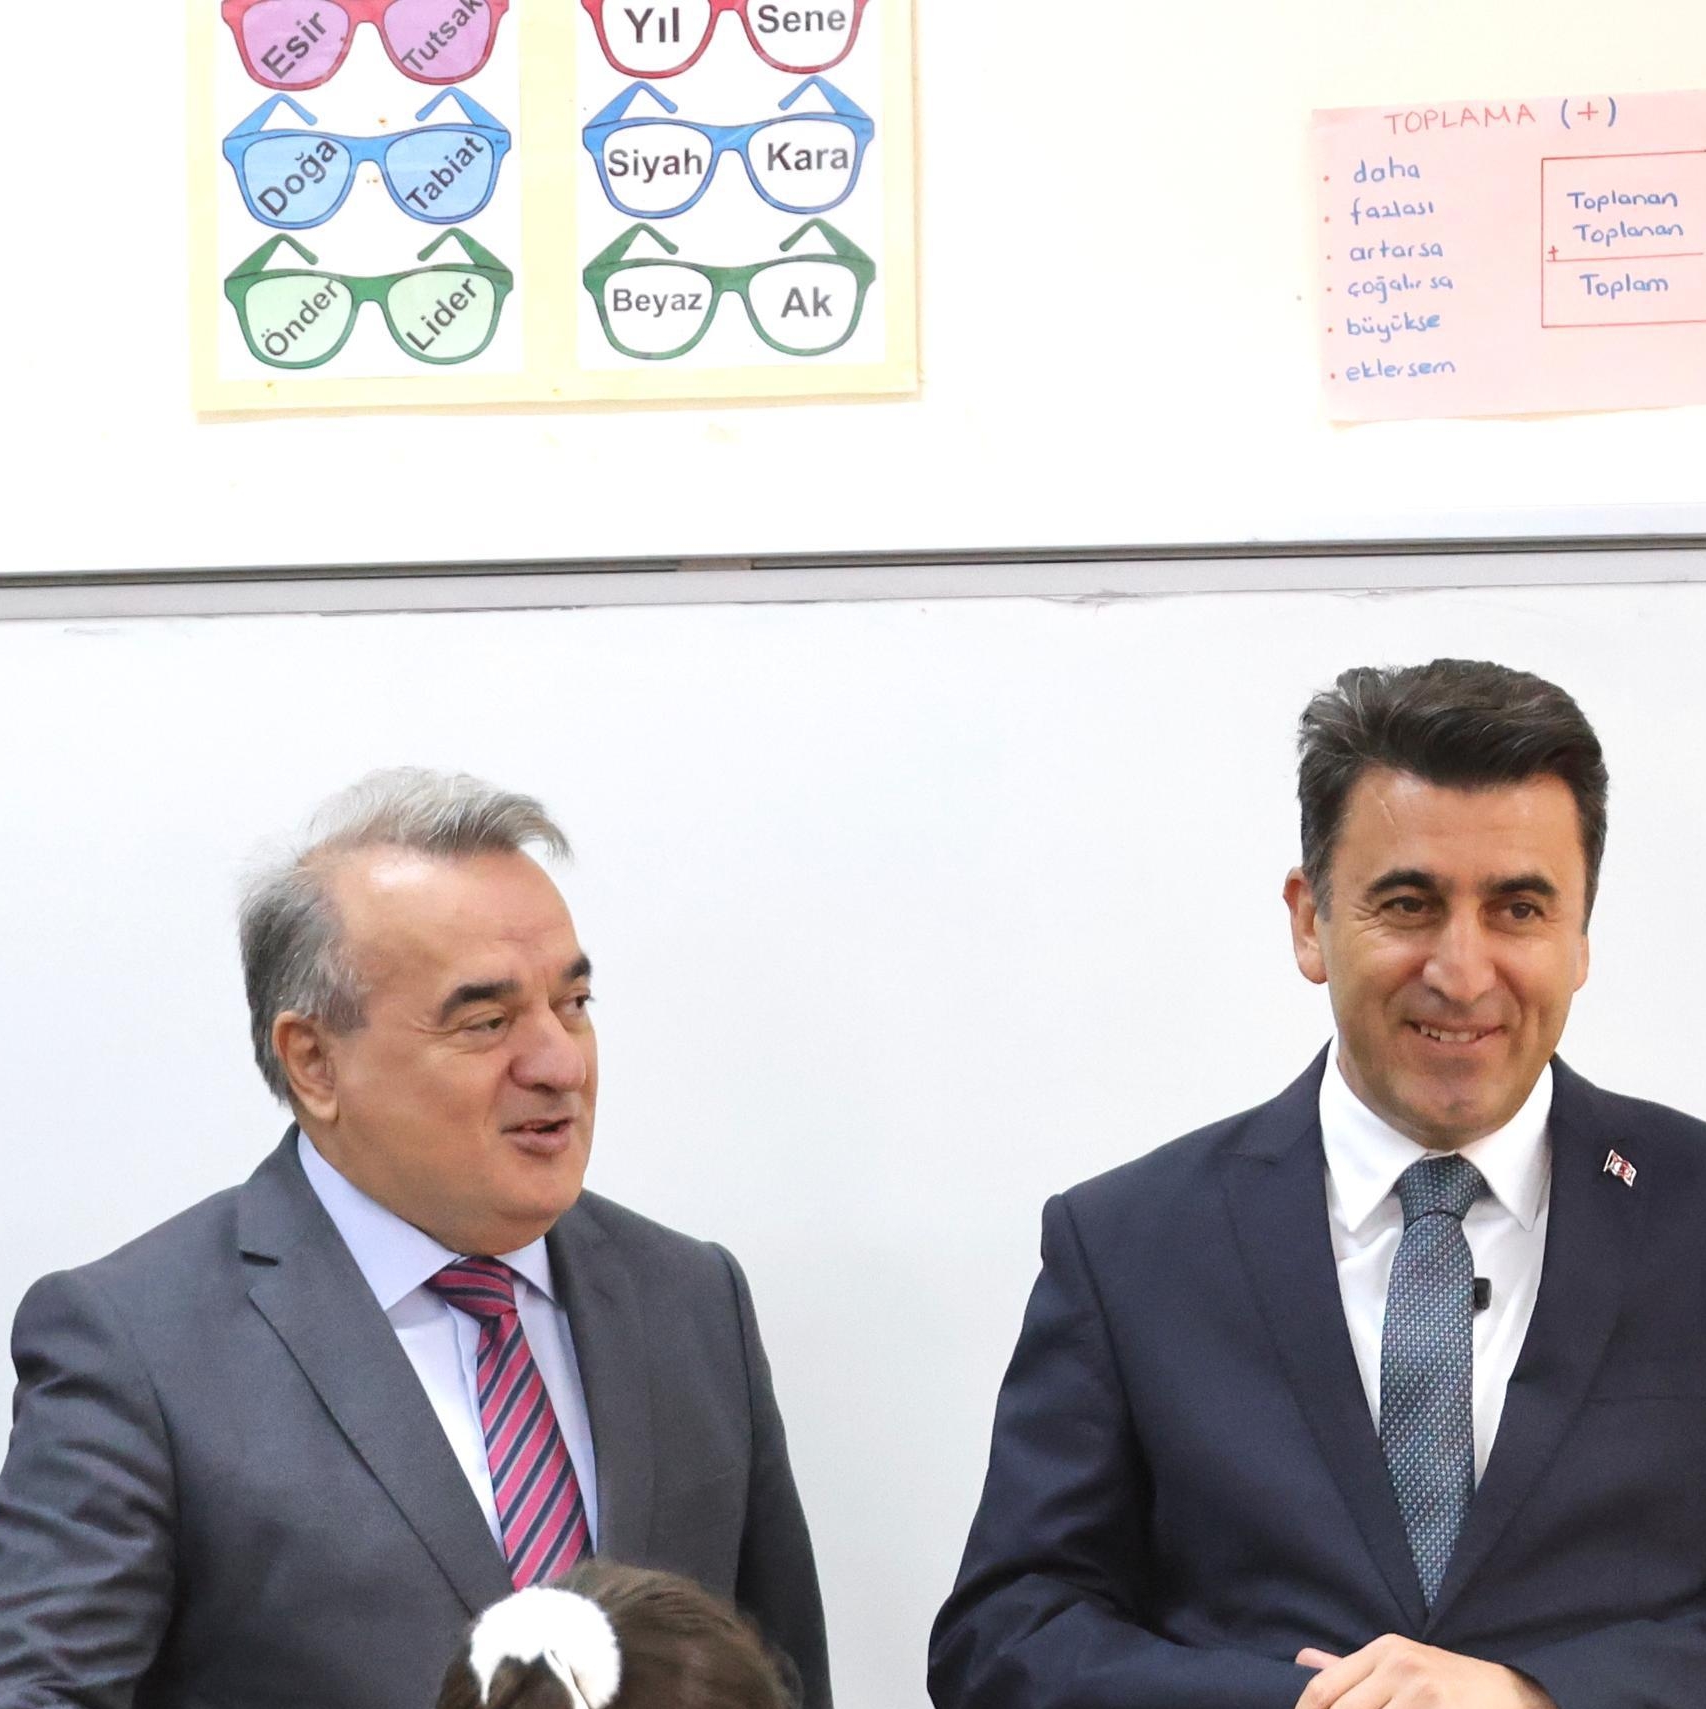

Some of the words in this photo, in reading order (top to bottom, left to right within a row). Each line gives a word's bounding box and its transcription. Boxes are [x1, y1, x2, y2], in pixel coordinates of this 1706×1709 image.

[626, 6, 680, 44] Yıl
[757, 4, 847, 34] Sene
[261, 11, 327, 80] Esir
[401, 0, 484, 71] Tutsak
[1384, 103, 1536, 135] TOPLAMA
[258, 135, 341, 218] Doğa
[404, 135, 487, 214] Tabiat
[607, 149, 703, 185] Siyah
[767, 141, 850, 172] Kara
[1353, 156, 1421, 184] daha
[1350, 197, 1435, 226] fazlası
[1566, 190, 1678, 213] Toplanan
[1572, 221, 1684, 247] Toplanan
[1350, 241, 1443, 261] artarsa
[1579, 273, 1669, 299] Toplam
[613, 288, 703, 316] Beyaz
[781, 286, 833, 319] Ak
[261, 279, 341, 361] Önder
[407, 277, 480, 353] Lider
[1347, 312, 1442, 343] büyükse
[1345, 358, 1456, 382] eklersem
